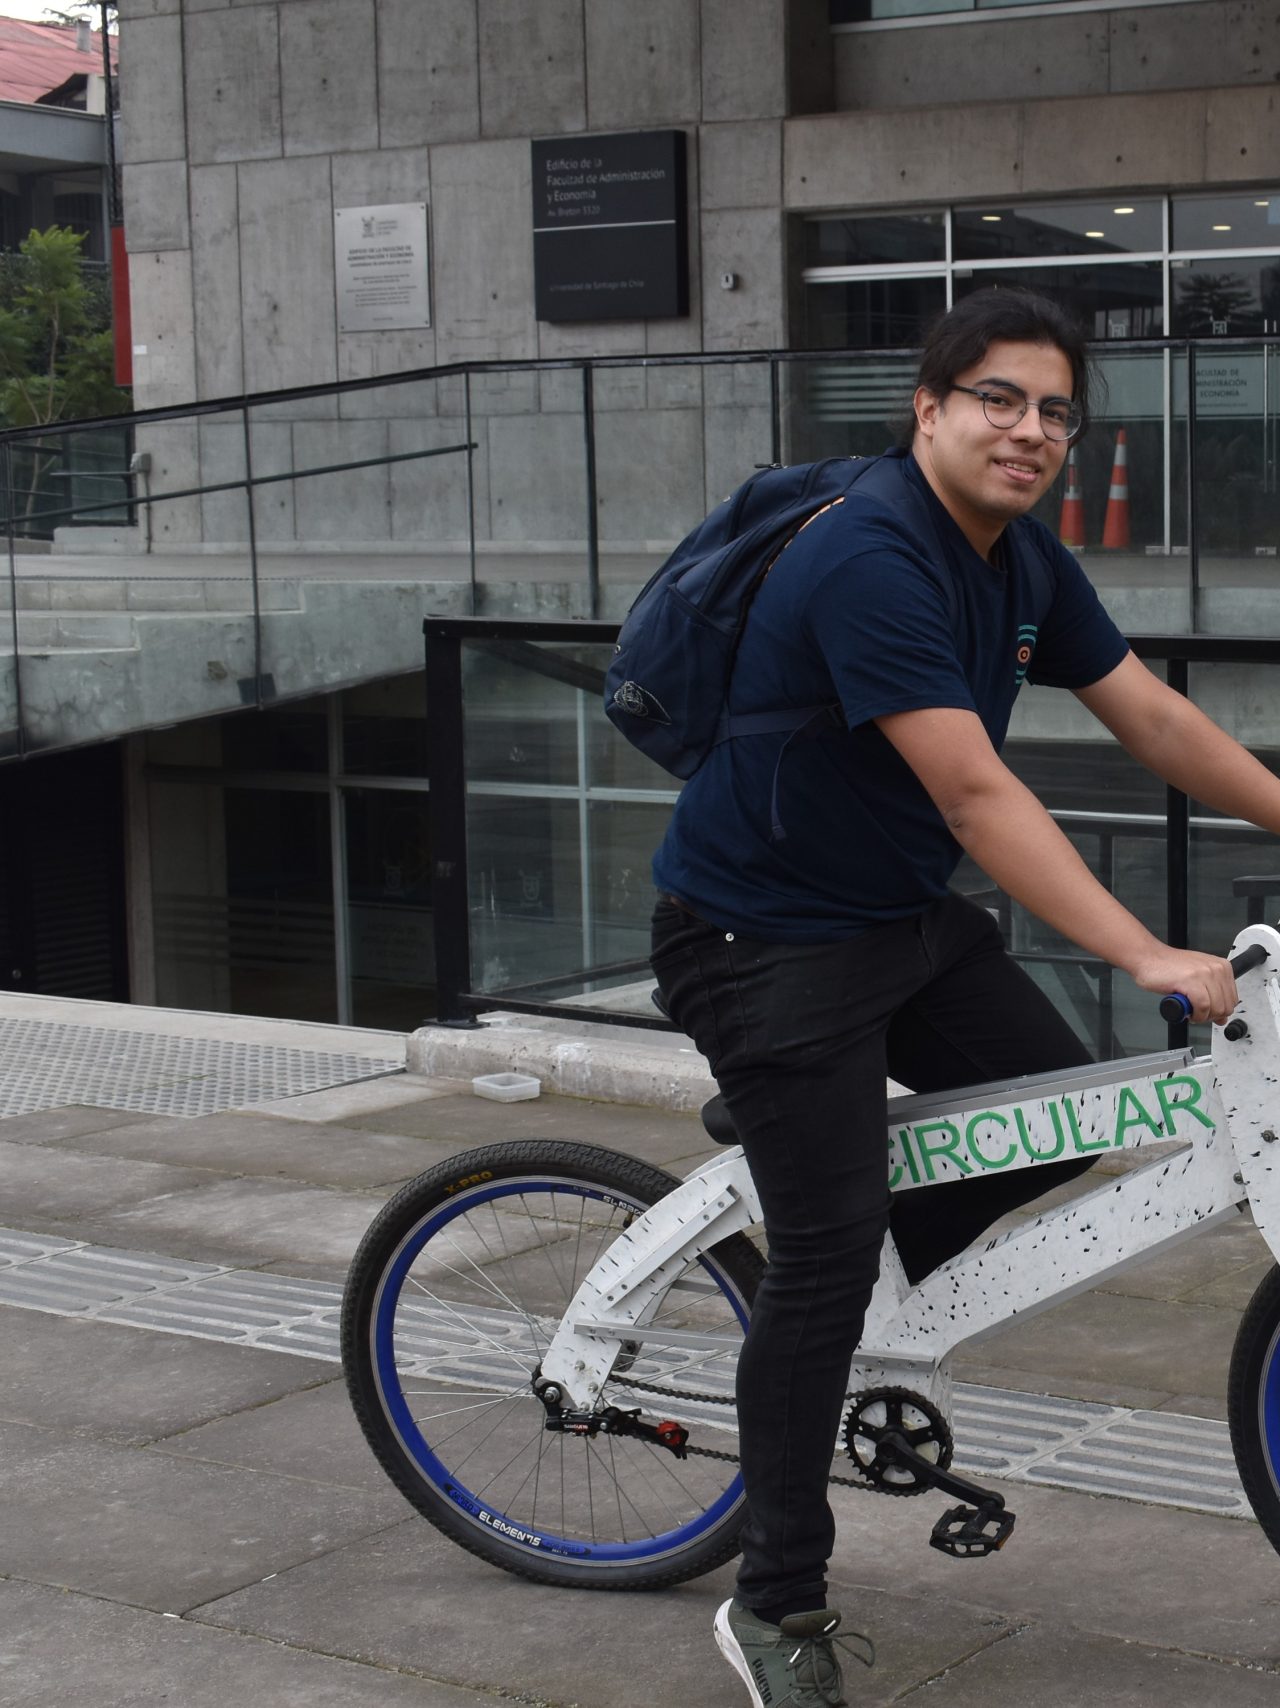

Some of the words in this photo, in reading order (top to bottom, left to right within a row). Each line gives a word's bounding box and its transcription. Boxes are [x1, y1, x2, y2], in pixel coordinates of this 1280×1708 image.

[546, 158, 578, 171] Edificio
[580, 157, 592, 169] de
[547, 173, 584, 186] Facultad
[586, 172, 598, 184] de
[599, 168, 666, 183] Administración
[1196, 368, 1228, 377] ACULTAD
[1196, 378, 1248, 386] MINISTRACIÓN
[444, 1170, 494, 1193] X-PRO
[752, 1656, 773, 1705] PUMA
